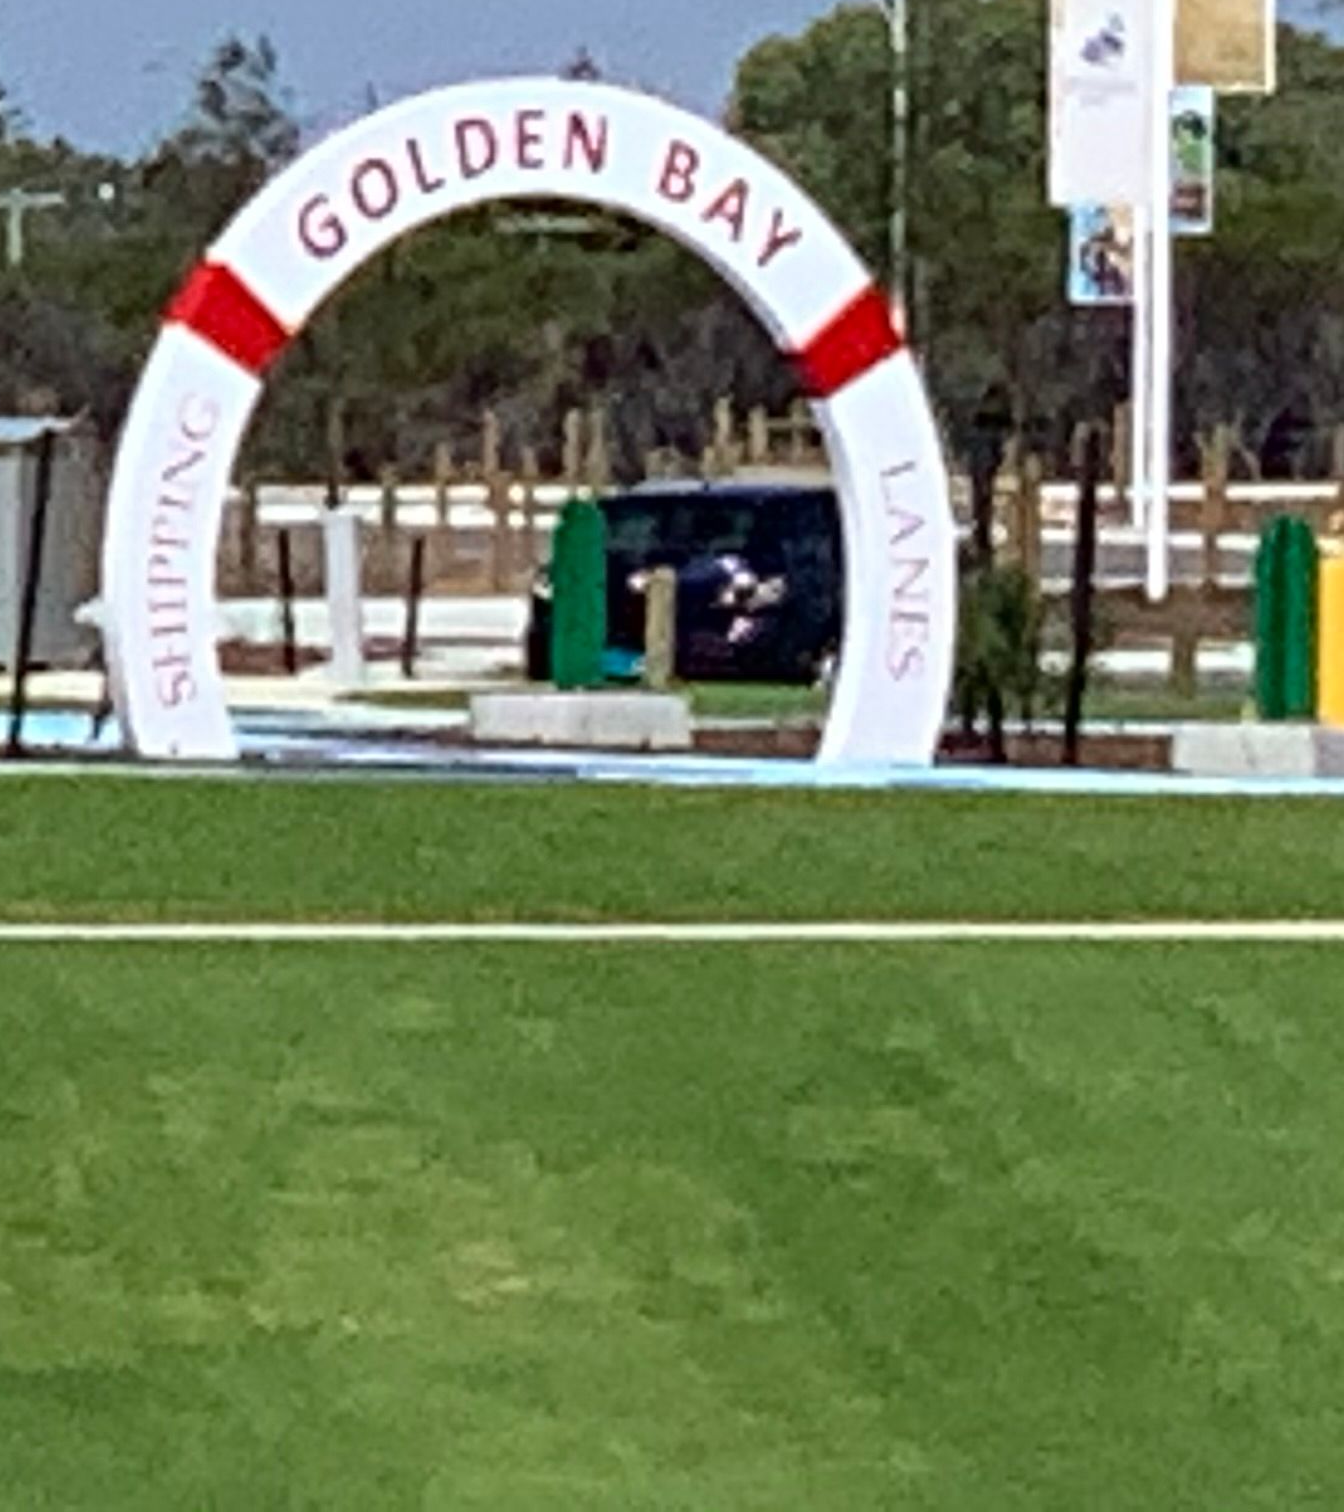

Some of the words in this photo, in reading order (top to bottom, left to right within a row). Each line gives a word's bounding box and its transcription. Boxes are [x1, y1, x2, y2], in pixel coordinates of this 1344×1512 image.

[297, 108, 609, 259] GOLDEN
[657, 140, 802, 269] BAY
[147, 392, 220, 710] SHIPPING
[879, 460, 929, 681] LANES
